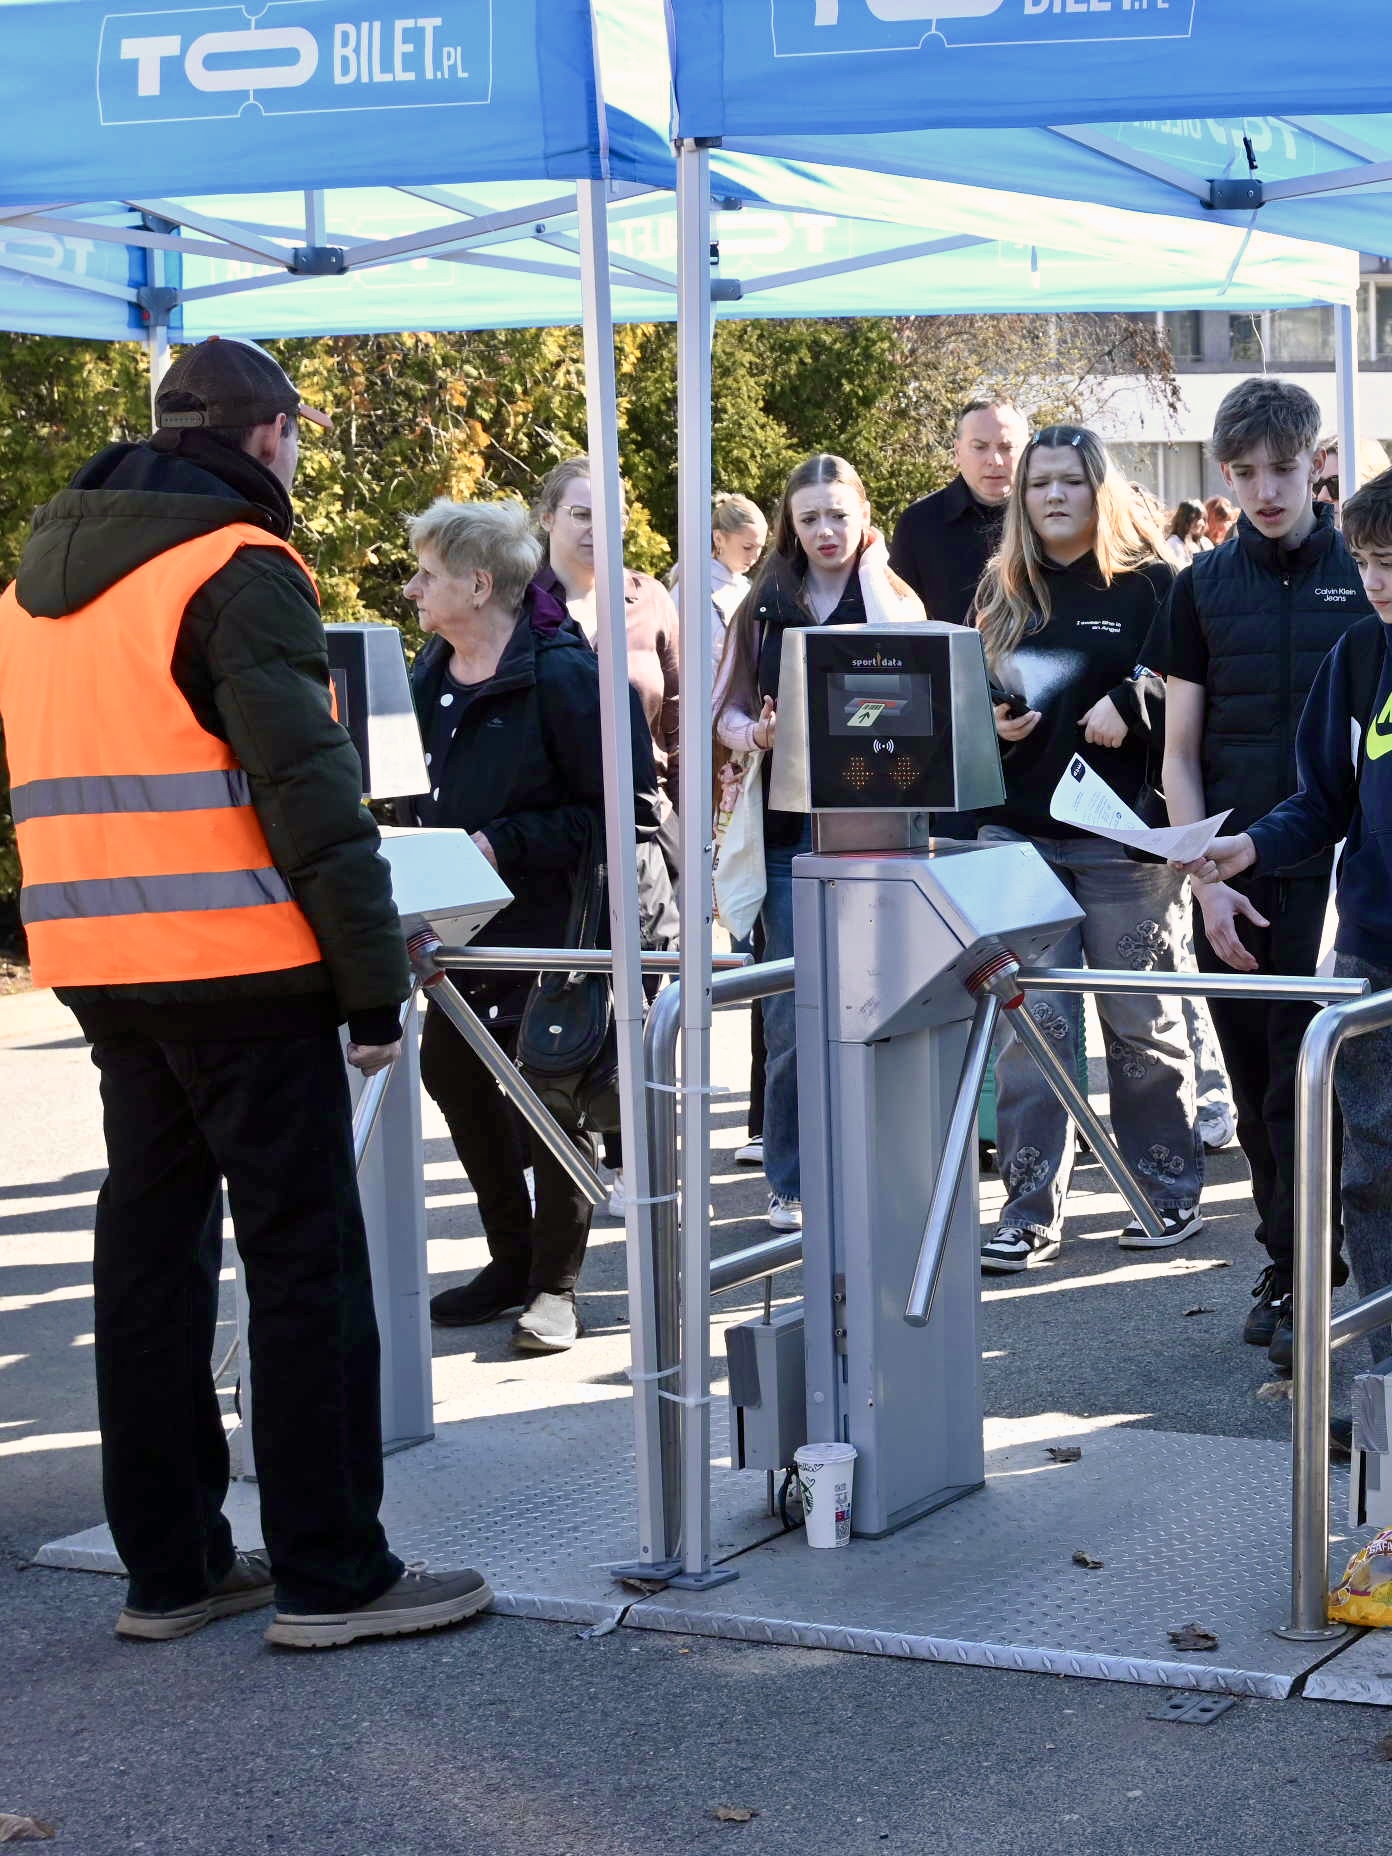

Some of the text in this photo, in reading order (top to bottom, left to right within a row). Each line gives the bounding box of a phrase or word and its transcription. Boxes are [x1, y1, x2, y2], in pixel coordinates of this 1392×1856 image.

[120, 26, 319, 96] TO
[1314, 587, 1338, 595] Calvin
[851, 658, 903, 667] sport data
